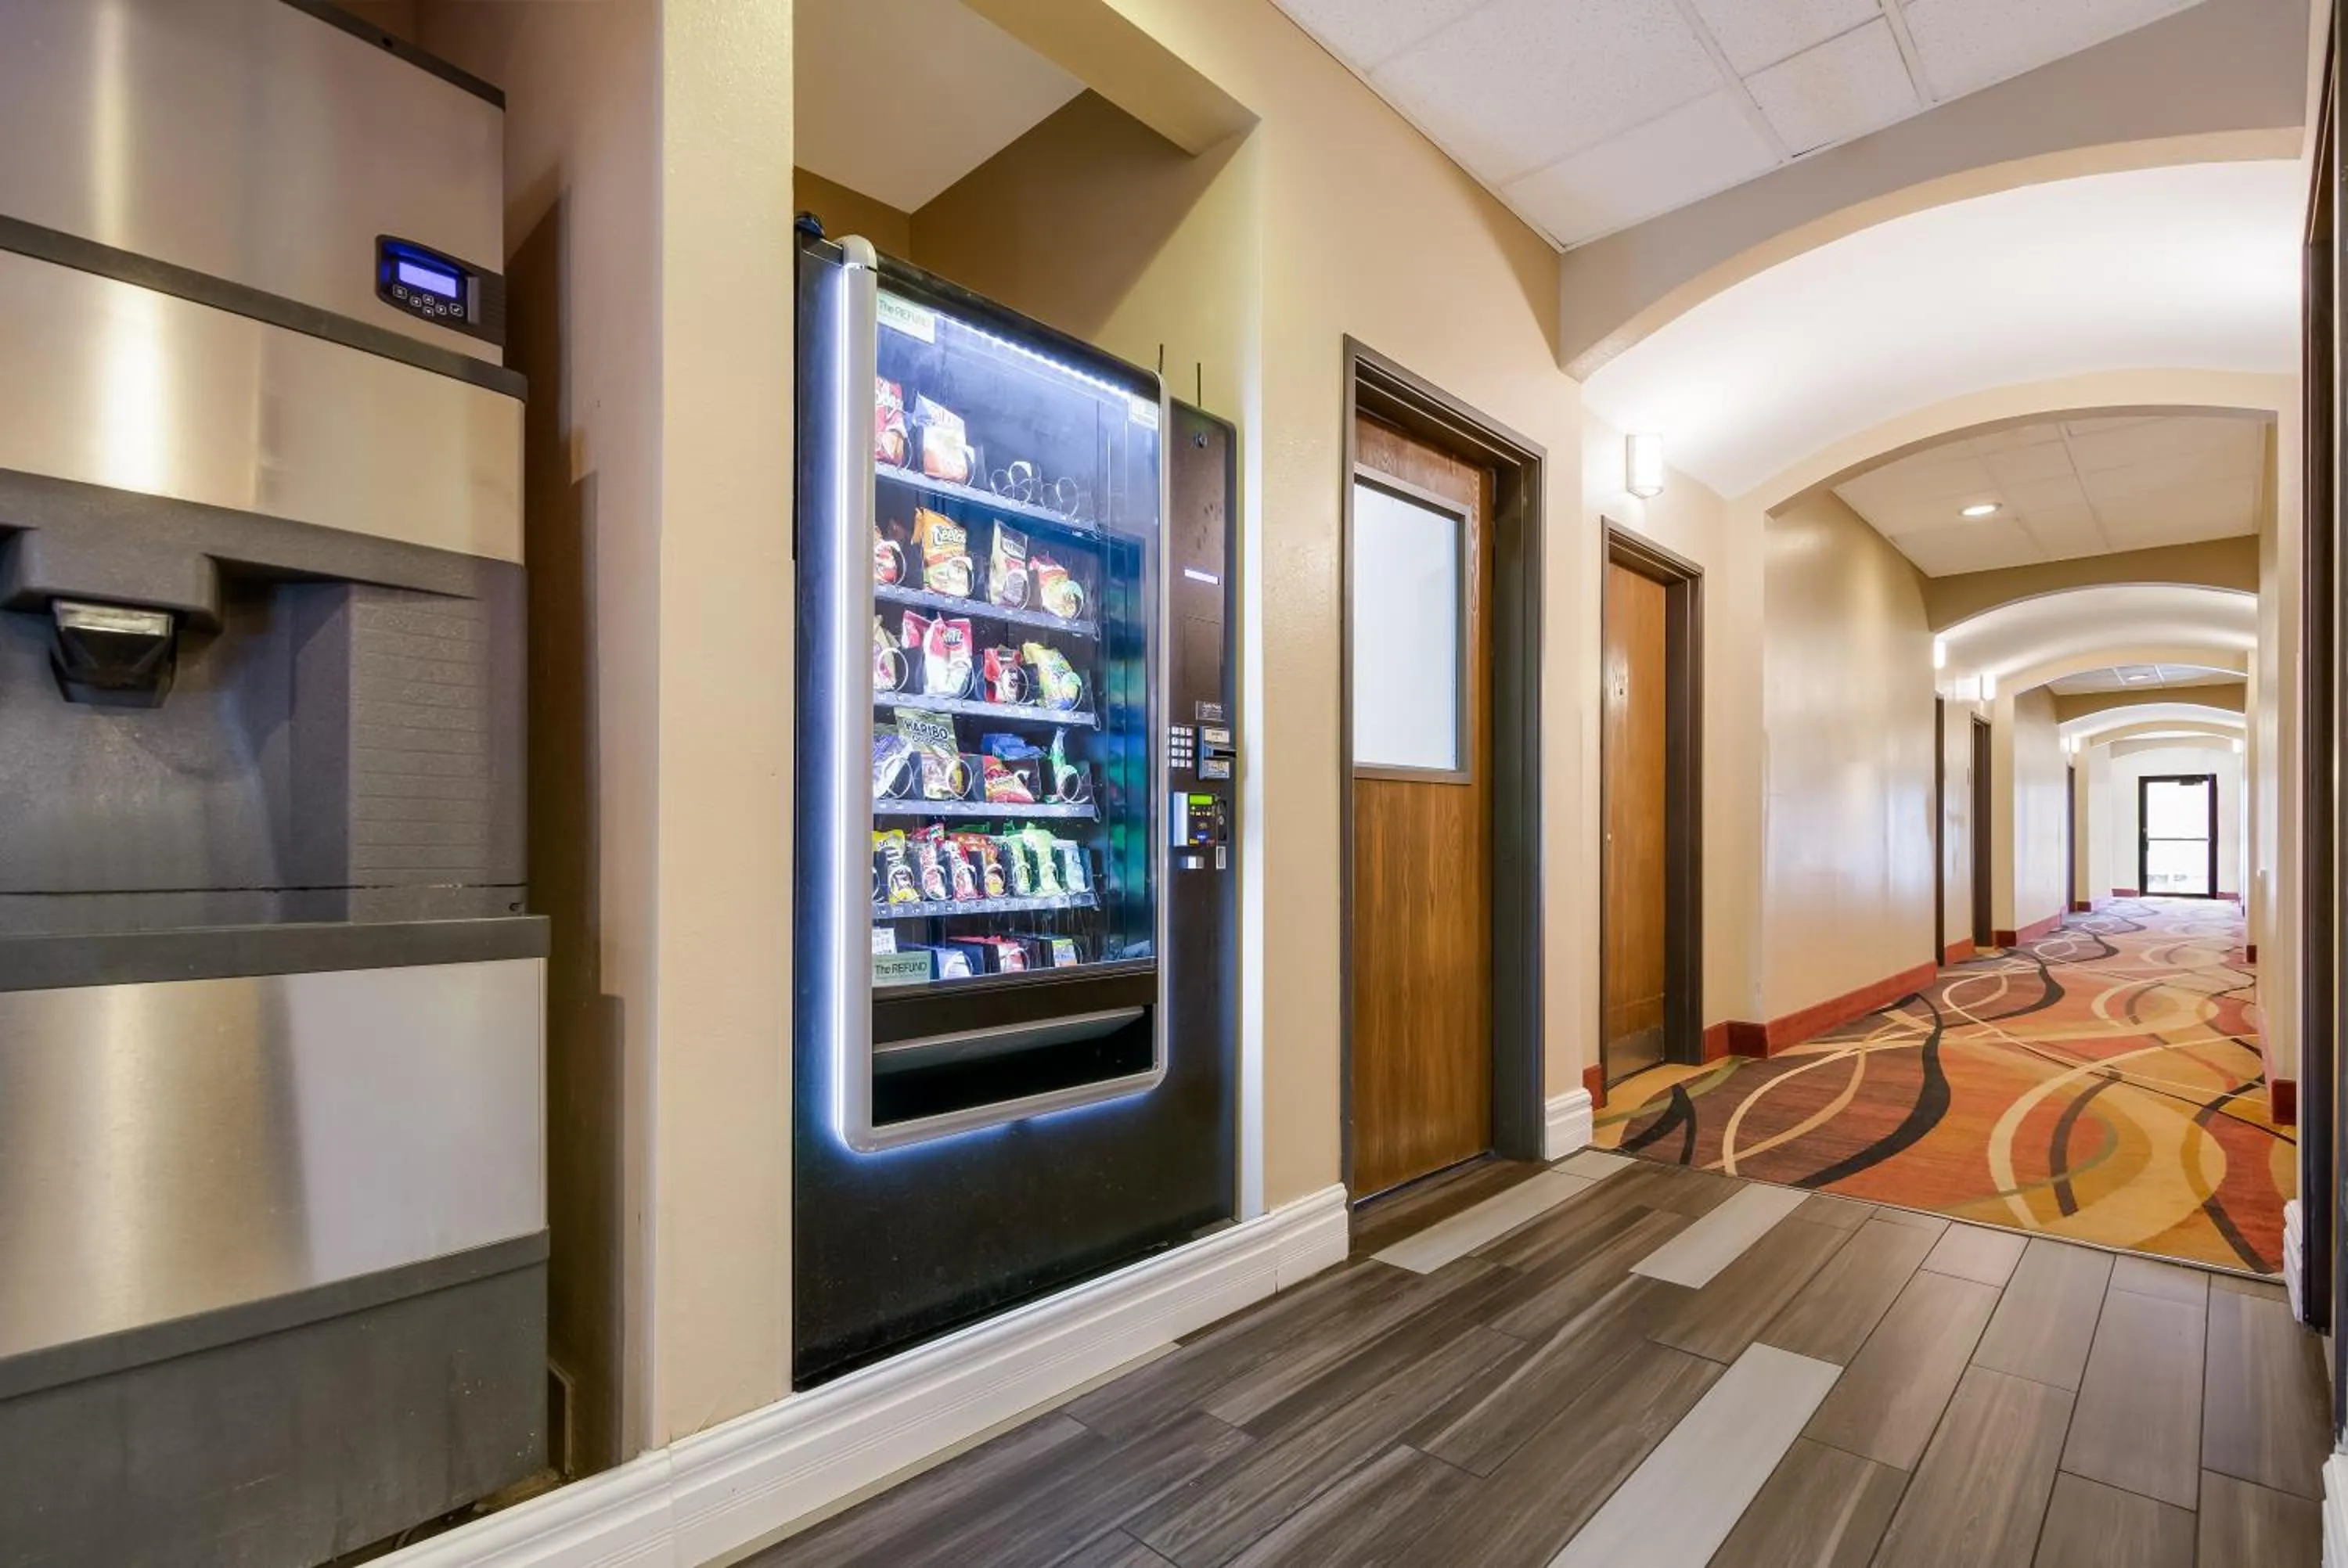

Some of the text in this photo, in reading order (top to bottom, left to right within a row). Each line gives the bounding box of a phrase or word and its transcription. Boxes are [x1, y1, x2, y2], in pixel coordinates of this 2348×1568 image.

[904, 719, 948, 739] HARIBO
[875, 962, 927, 974] The REFUND
